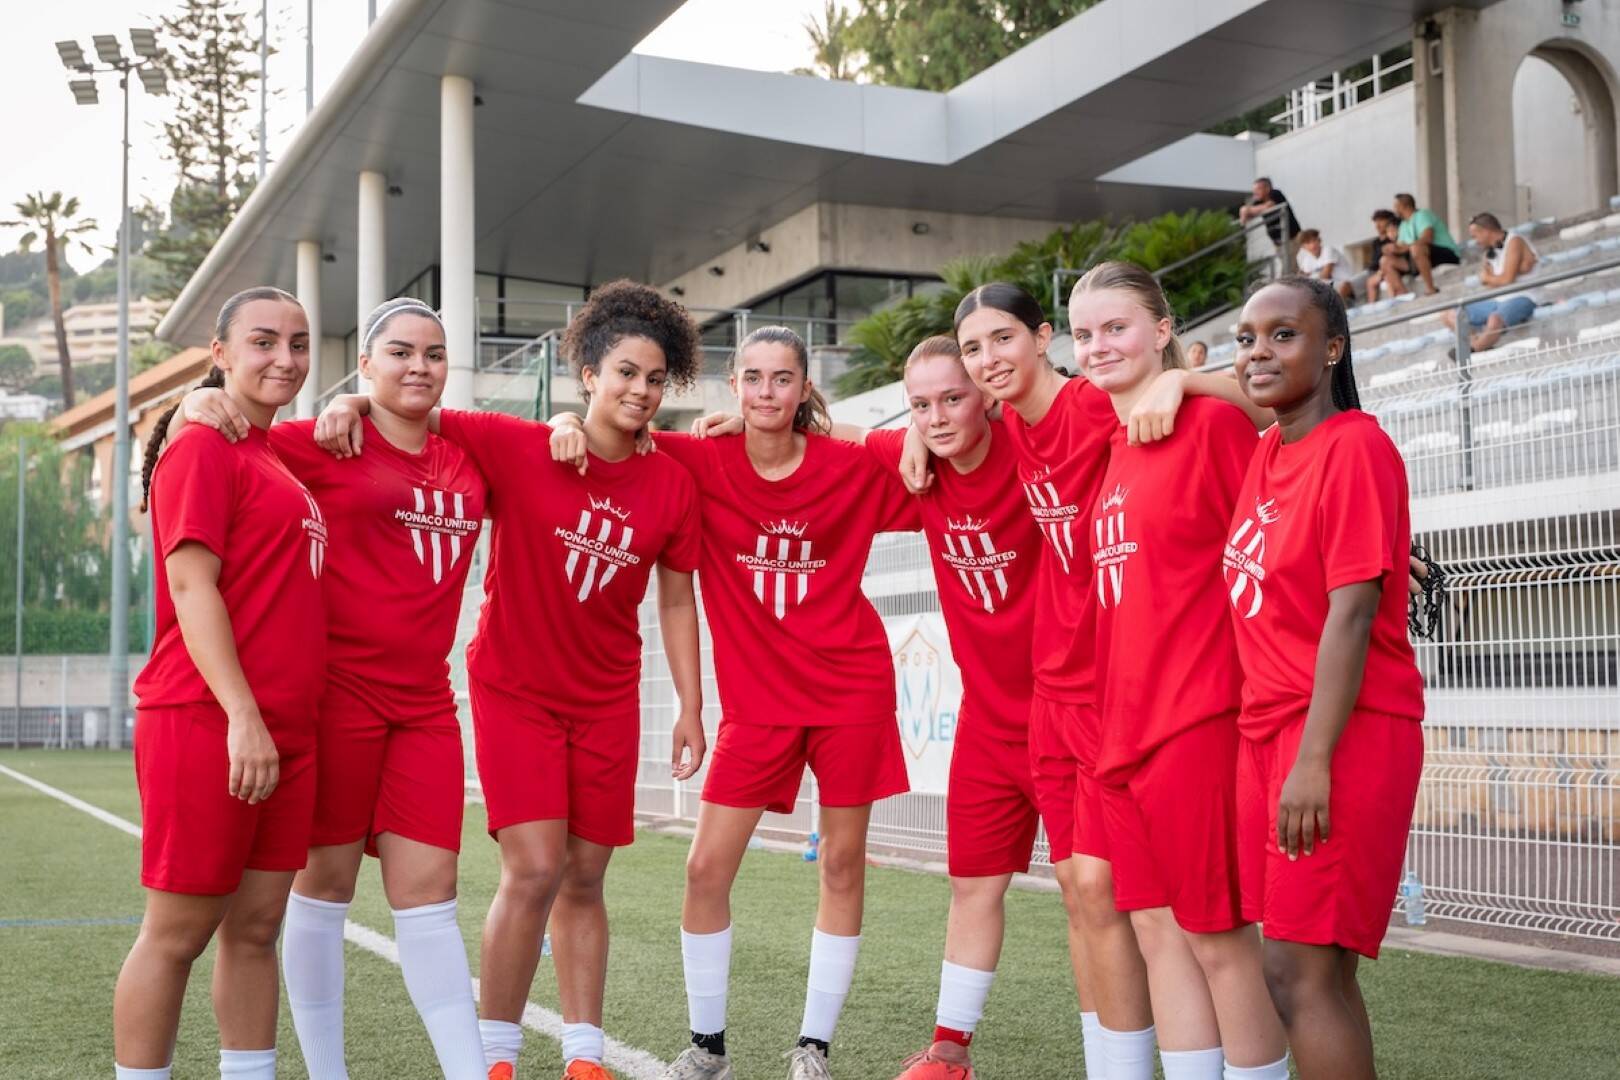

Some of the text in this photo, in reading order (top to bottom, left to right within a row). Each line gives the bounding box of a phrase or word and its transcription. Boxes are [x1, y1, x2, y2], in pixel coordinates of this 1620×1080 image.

[395, 509, 443, 526] MONACO
[444, 518, 478, 531] UNITED
[554, 526, 640, 564] MONACO UNITED
[736, 553, 827, 569] MONACO UNITED
[942, 551, 1017, 566] MONACO UNITED
